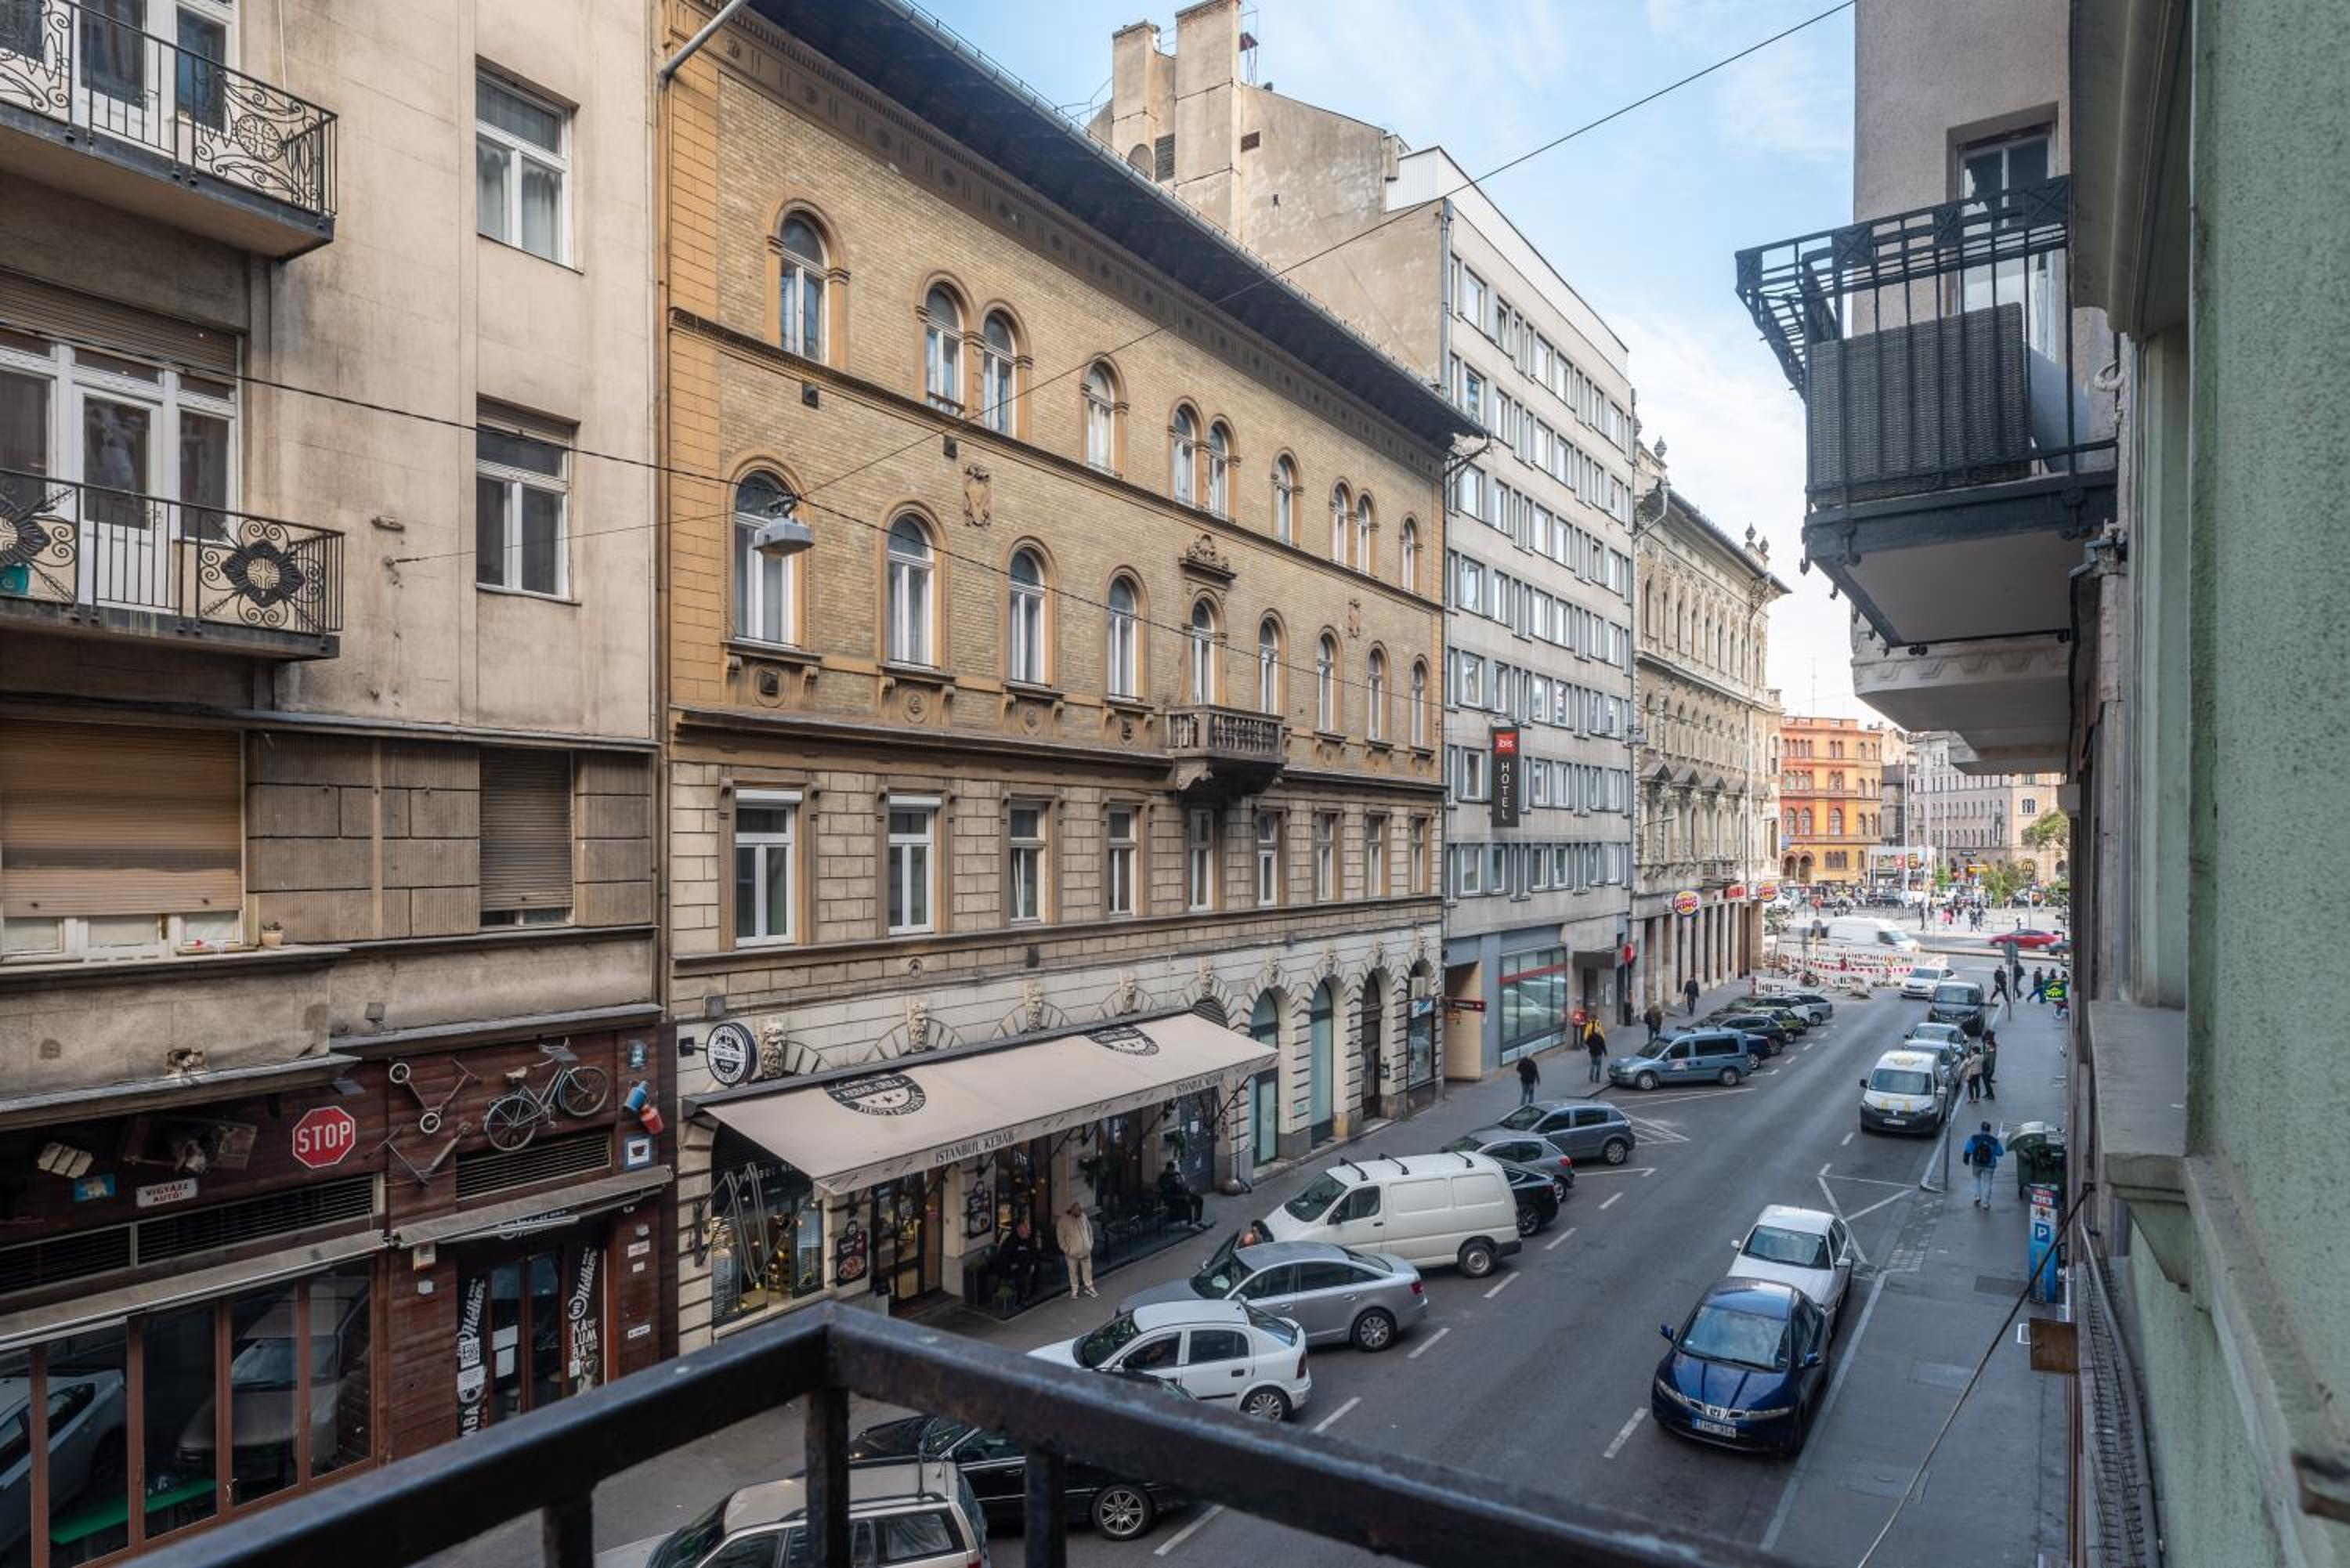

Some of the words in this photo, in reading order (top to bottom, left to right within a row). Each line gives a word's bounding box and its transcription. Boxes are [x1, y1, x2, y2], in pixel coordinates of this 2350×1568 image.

[1497, 739, 1514, 748] ibis
[1501, 761, 1510, 820] HOTEL
[1677, 900, 1697, 909] KING
[298, 1121, 351, 1154] STOP
[935, 1140, 981, 1164] ISTANBUL
[985, 1132, 1015, 1150] KEBAB
[2037, 1227, 2048, 1238] P
